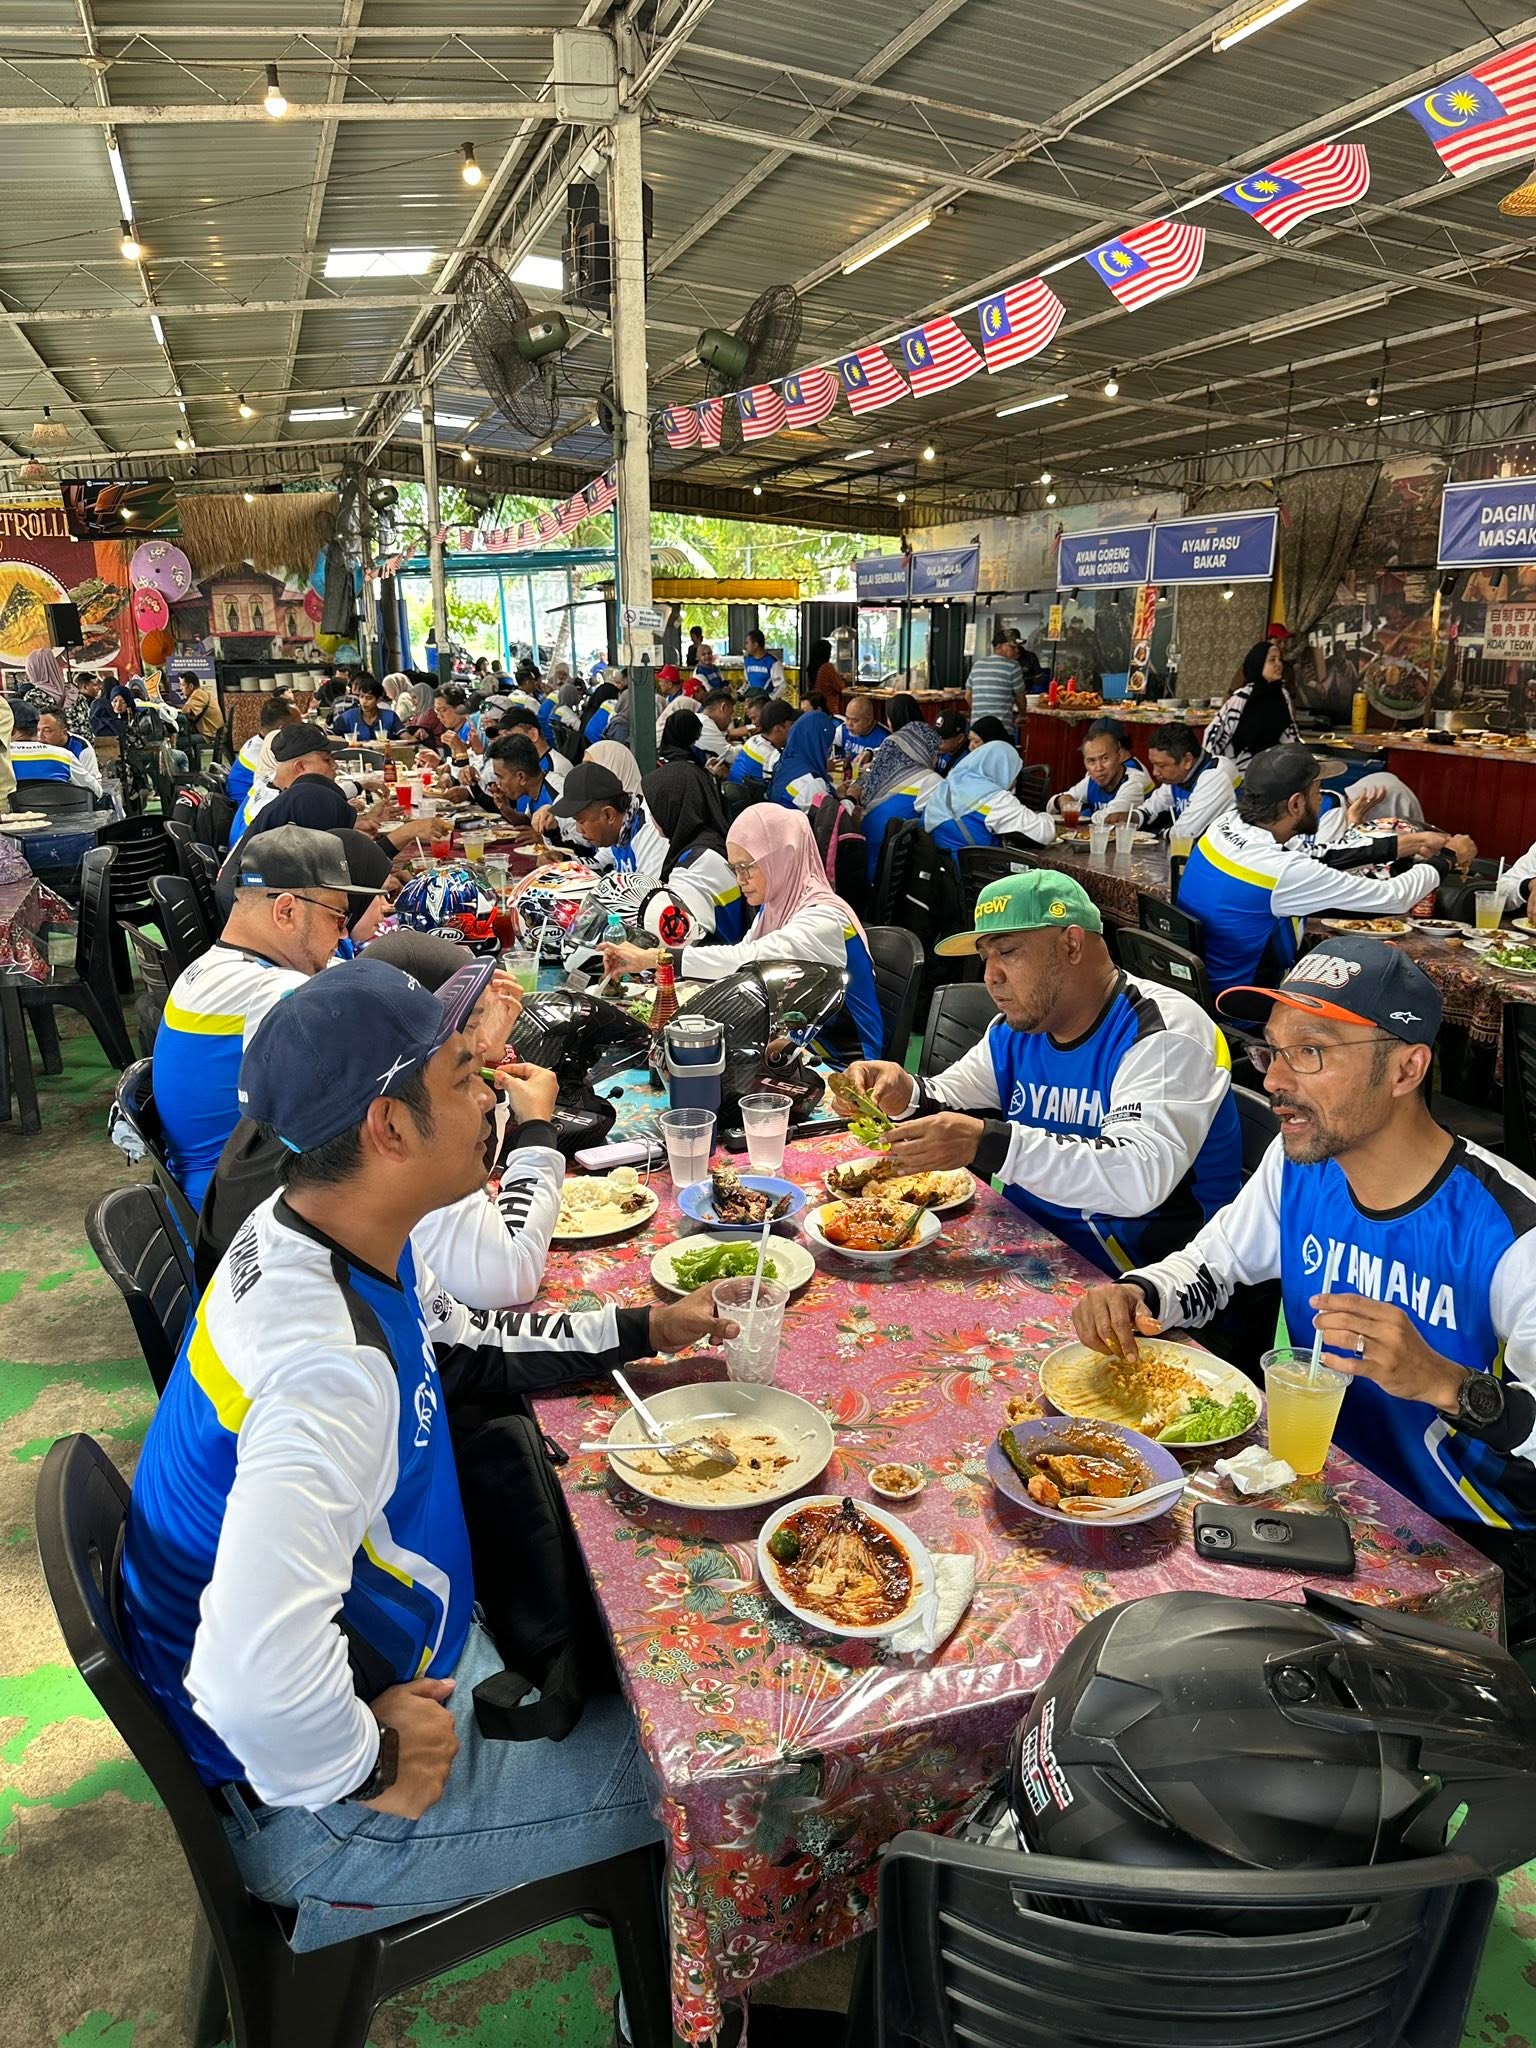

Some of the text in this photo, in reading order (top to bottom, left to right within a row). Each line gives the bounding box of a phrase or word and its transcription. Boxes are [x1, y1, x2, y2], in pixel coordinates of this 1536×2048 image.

[1181, 536, 1240, 554] AYAM PASU
[1478, 528, 1536, 547] MASAK
[1076, 547, 1130, 563] AYAM GORENG
[1193, 554, 1226, 569] BAKAR
[1078, 561, 1129, 577] IKAN GORENG
[859, 571, 906, 586] GULAI SEMBILANG
[1510, 640, 1533, 650] TEOW
[434, 931, 460, 940] Arai
[1328, 1238, 1457, 1330] YAMAHA
